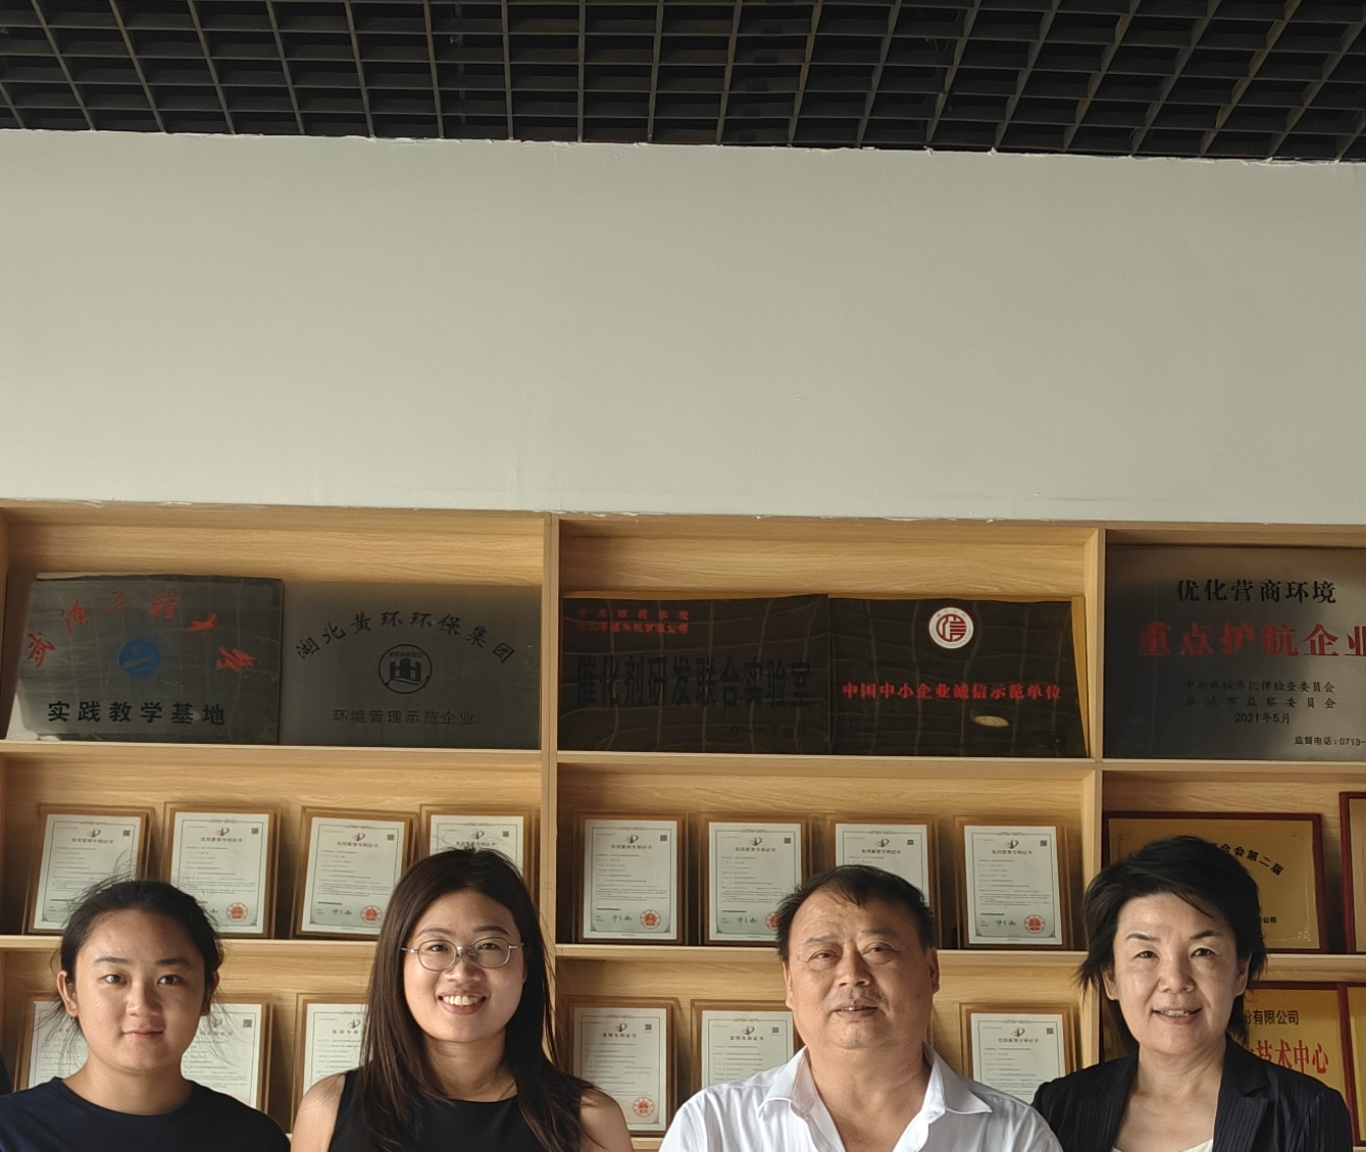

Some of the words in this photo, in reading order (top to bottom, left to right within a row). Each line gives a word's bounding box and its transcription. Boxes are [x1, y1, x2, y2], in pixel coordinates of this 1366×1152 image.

[1175, 579, 1336, 604] 优化营商环境
[295, 610, 516, 664] 湖北黄环环保集团
[841, 682, 1062, 700] 中国中小企业诚信示范单位
[48, 700, 225, 725] 实践教学基地
[332, 709, 477, 725] 环境管理示范企业
[1234, 712, 1290, 724] 2021年5月
[1246, 1039, 1329, 1075] 技术中心
